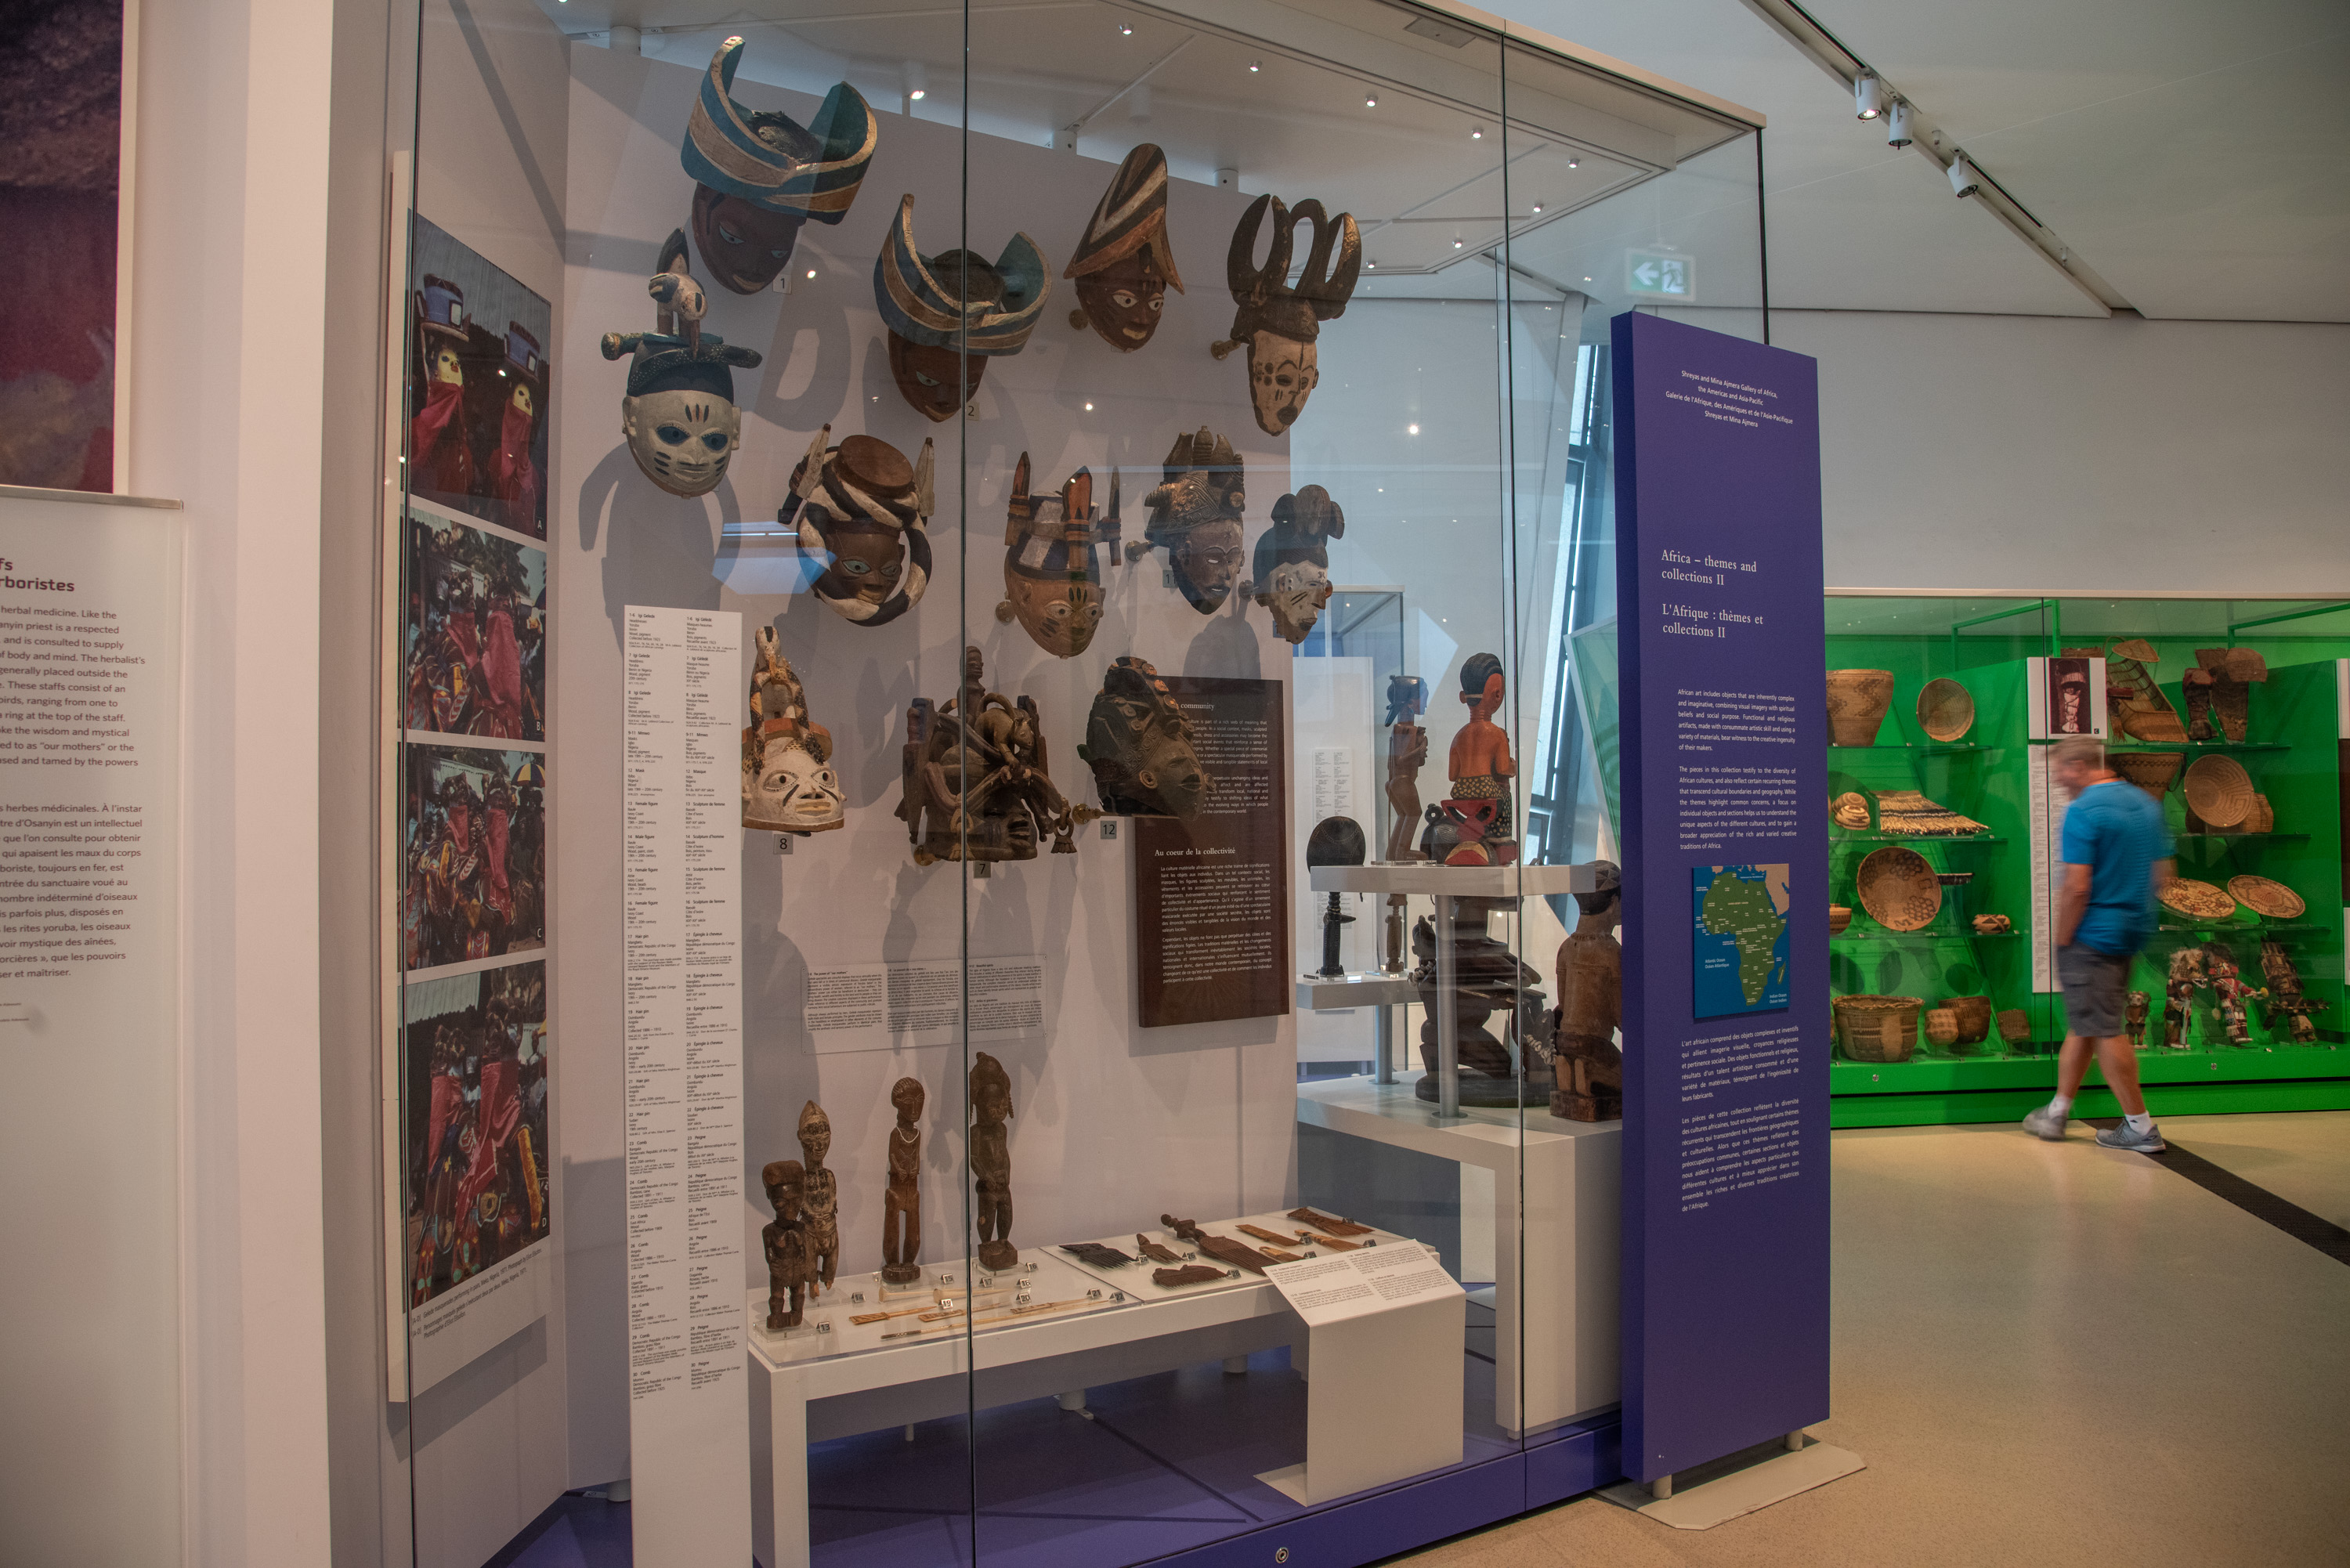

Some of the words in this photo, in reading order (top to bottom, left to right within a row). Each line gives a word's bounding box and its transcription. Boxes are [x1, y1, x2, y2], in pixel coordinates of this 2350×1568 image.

[780, 278, 785, 288] 1
[1681, 370, 1700, 381] Shreyas
[1710, 377, 1723, 385] Mina
[1723, 381, 1741, 389] Ajmera
[1741, 384, 1757, 395] Gallery
[1763, 389, 1778, 399] Africa,
[1707, 388, 1728, 398] Americas
[1738, 395, 1763, 406] Asia-Pacific
[1665, 391, 1683, 401] Galerie
[1723, 403, 1748, 414] Amériques
[968, 406, 974, 416] 2
[1705, 410, 1723, 421] Shreyas
[1741, 419, 1759, 428] Ajmera
[537, 520, 542, 529] A
[1661, 550, 1691, 564] Africa
[1705, 555, 1737, 570] themes
[1741, 561, 1757, 573] and
[1661, 568, 1712, 584] collections
[1716, 574, 1724, 586] II
[1, 605, 31, 615] herbal
[34, 609, 79, 617] medicine.
[81, 610, 100, 619] Like
[102, 611, 118, 620] the
[1662, 603, 1708, 622] L'Afrique
[1719, 609, 1752, 623] thèmes
[1755, 616, 1763, 625] et
[1662, 622, 1714, 637] collections
[1718, 627, 1726, 638] II
[34, 638, 80, 647] consulted
[94, 641, 125, 651] supply
[7, 651, 31, 661] body
[52, 653, 78, 662] mind.
[81, 654, 99, 663] The
[0, 667, 41, 677] generally
[43, 667, 74, 677] placed
[7, 681, 37, 690] These
[27, 699, 63, 707] ranging
[1180, 703, 1214, 711] community
[5, 713, 24, 721] ring
[38, 712, 53, 721] the
[56, 713, 71, 722] top
[537, 721, 540, 731] B
[92, 729, 130, 738] mystical
[74, 757, 86, 767] by
[88, 757, 103, 766] the
[1103, 825, 1115, 835] 12
[779, 838, 787, 849] 8
[2, 850, 17, 858] qui
[19, 850, 58, 858] apaisent
[979, 863, 985, 874] 7
[43, 923, 78, 934] yoruba,
[537, 928, 541, 938] C
[542, 1218, 547, 1227] D
